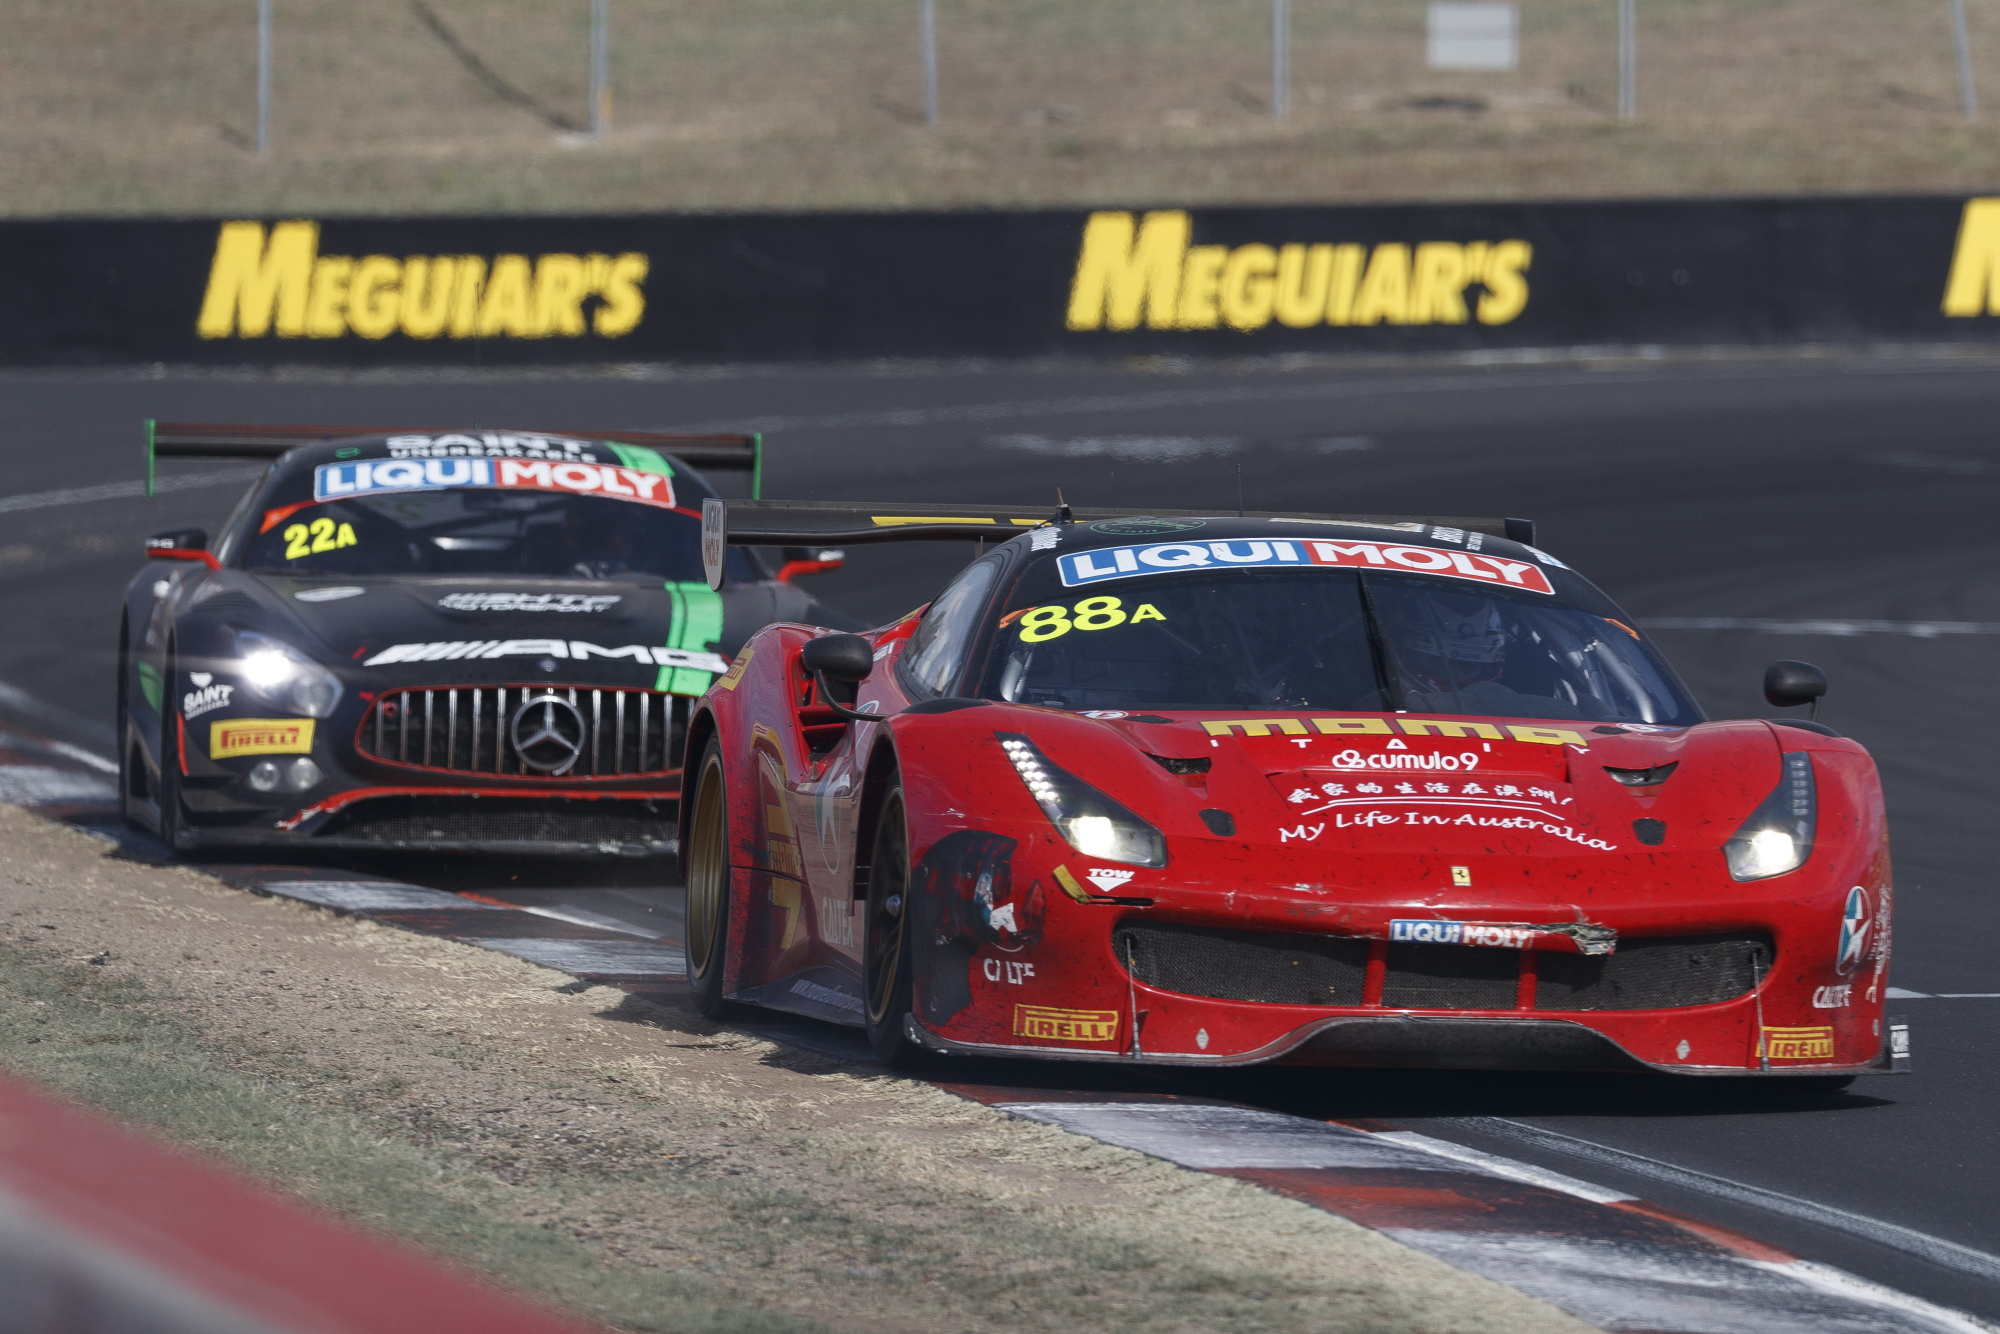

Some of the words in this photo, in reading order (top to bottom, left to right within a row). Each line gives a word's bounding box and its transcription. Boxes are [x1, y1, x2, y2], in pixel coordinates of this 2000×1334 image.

[197, 221, 649, 339] MEGUIAR'S
[1066, 210, 1532, 330] MEGUIAR'S
[325, 458, 490, 495] LIQUI
[501, 461, 660, 499] MOLY
[1073, 541, 1300, 579] LIQUI
[1312, 542, 1532, 584] MOLY
[183, 684, 235, 713] SAINT
[221, 727, 300, 750] PIRELLI
[1279, 822, 1325, 843] My
[1336, 810, 1400, 828] Life
[1408, 811, 1451, 826] In
[1453, 811, 1618, 852] Australia
[1088, 868, 1135, 879] TOW
[1393, 921, 1461, 943] LIQUI
[1463, 925, 1532, 949] MOLY
[1013, 1004, 1119, 1042] PIRELLI
